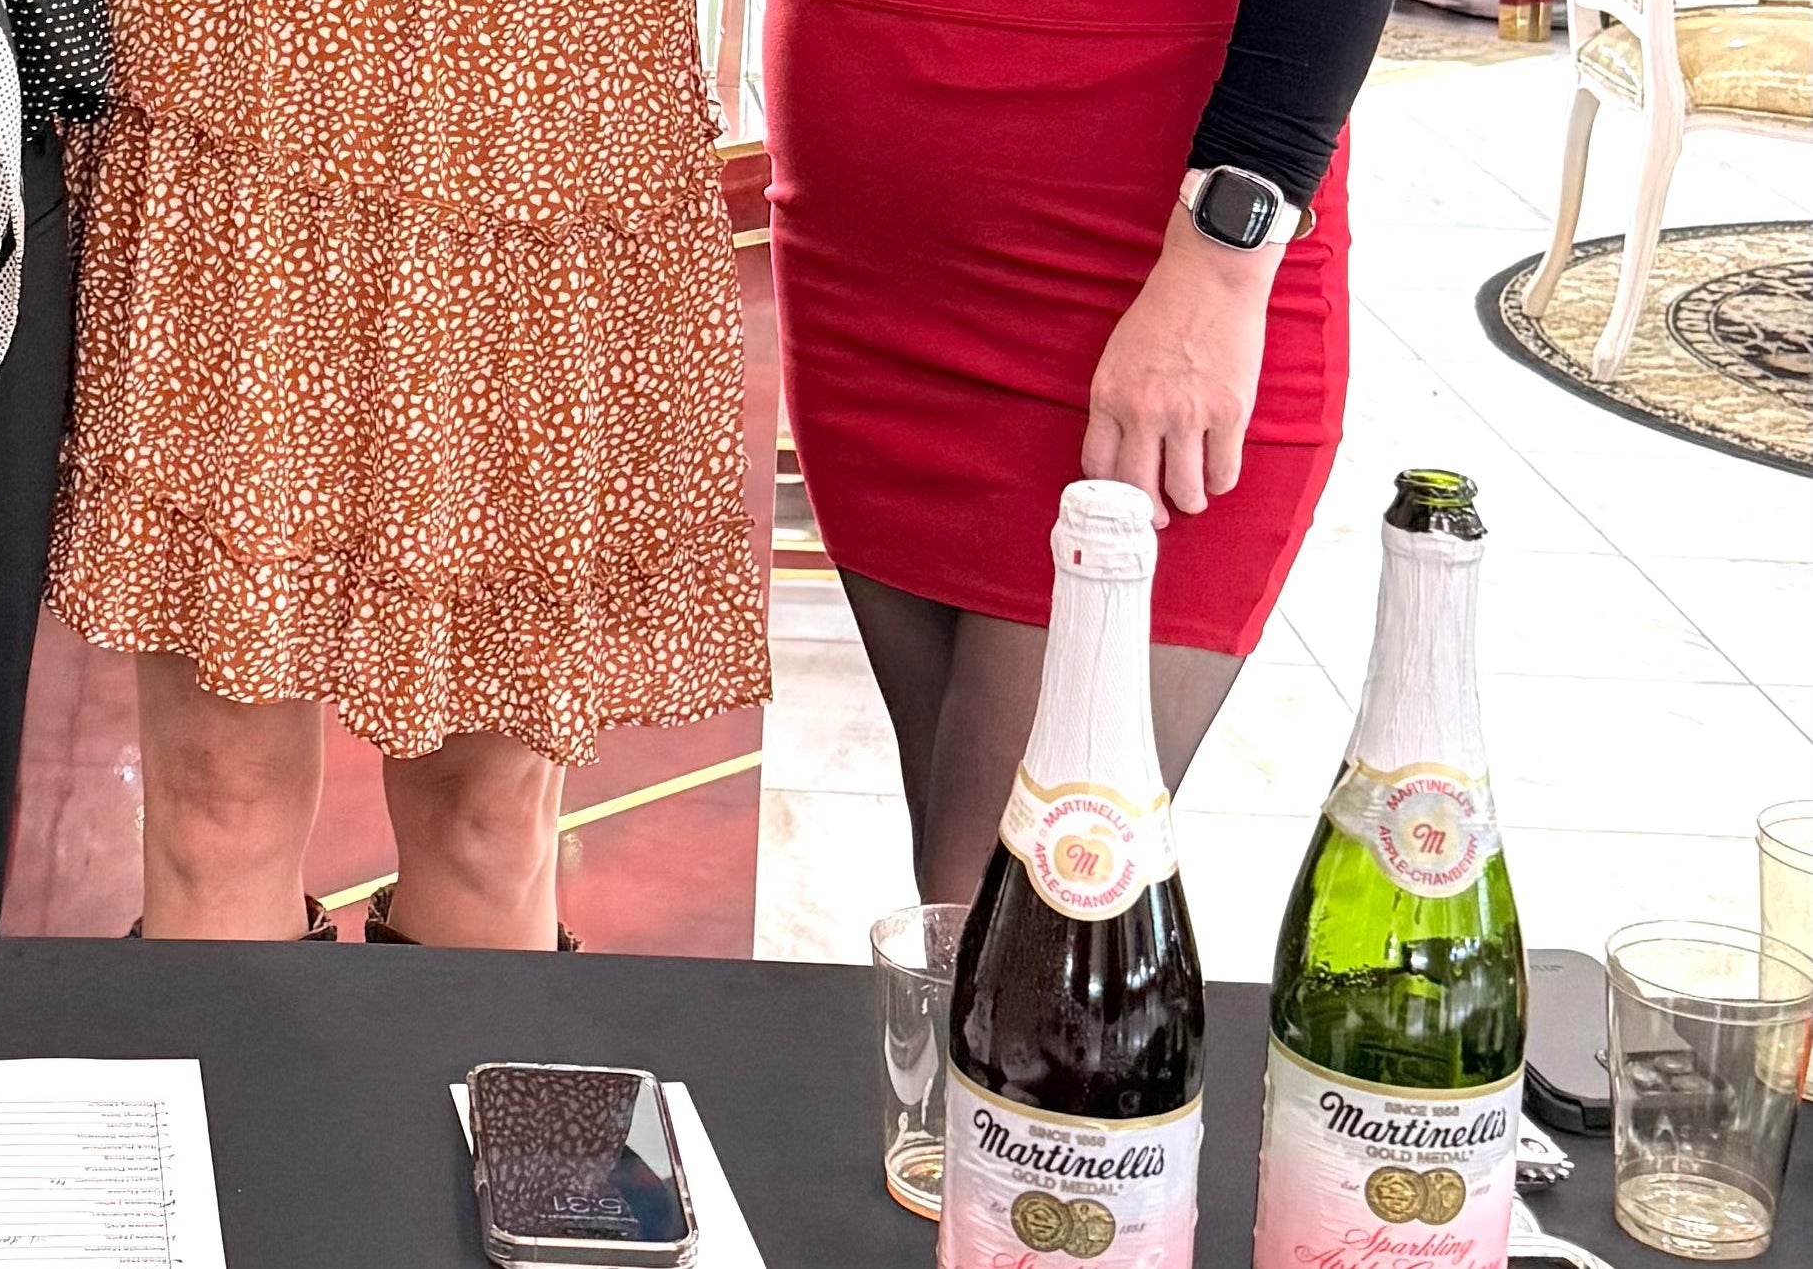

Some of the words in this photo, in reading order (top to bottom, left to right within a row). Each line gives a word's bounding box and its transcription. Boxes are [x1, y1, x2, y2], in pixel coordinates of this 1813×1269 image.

[1386, 779, 1476, 817] MARTINELLI'S
[1044, 799, 1134, 843] MARTINELLI'S
[1378, 825, 1478, 885] APPLE-CRANBERRY
[1035, 842, 1136, 908] APPLE-CRANBERRY
[1319, 1091, 1506, 1149] Martinelli's
[1385, 1102, 1427, 1117] SINCE
[973, 1109, 1165, 1180] Martinelli's
[1028, 1124, 1071, 1145] SINCE
[1366, 1145, 1412, 1163] GOLD
[1012, 1168, 1057, 1190] GOLD
[553, 1196, 622, 1215] 5:31
[1339, 1225, 1476, 1266] Sparkling
